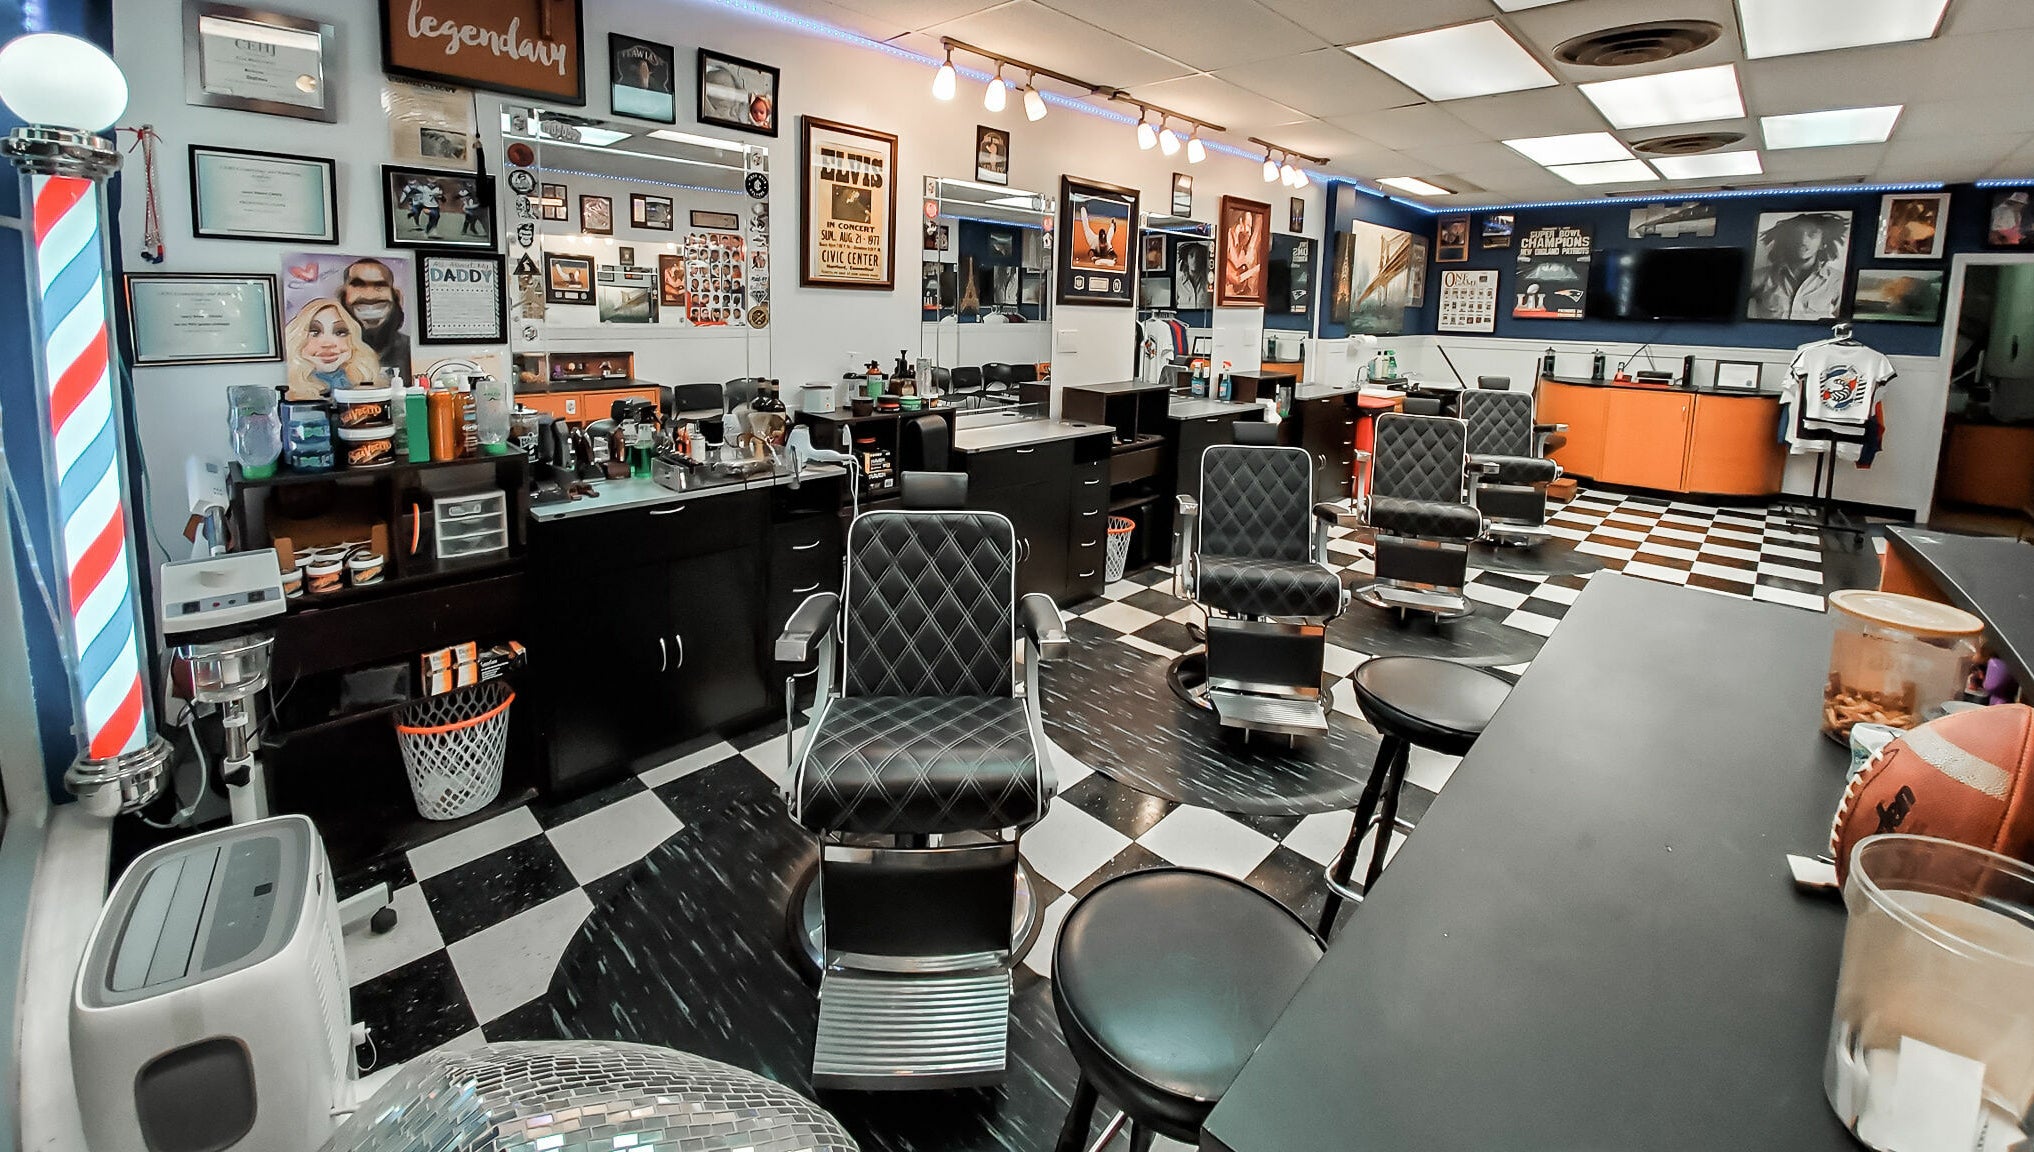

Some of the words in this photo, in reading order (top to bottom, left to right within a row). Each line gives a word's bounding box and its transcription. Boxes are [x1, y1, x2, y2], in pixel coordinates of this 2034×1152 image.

[407, 0, 567, 76] legendary
[820, 148, 883, 188] ELVIS
[838, 222, 875, 233] CONCERT
[1530, 230, 1555, 239] SUPER
[1559, 229, 1581, 238] BOWL
[1520, 236, 1590, 249] CHAMPIONS
[821, 249, 844, 264] CIVIC
[847, 251, 879, 267] CENTER
[430, 267, 492, 283] DADDY
